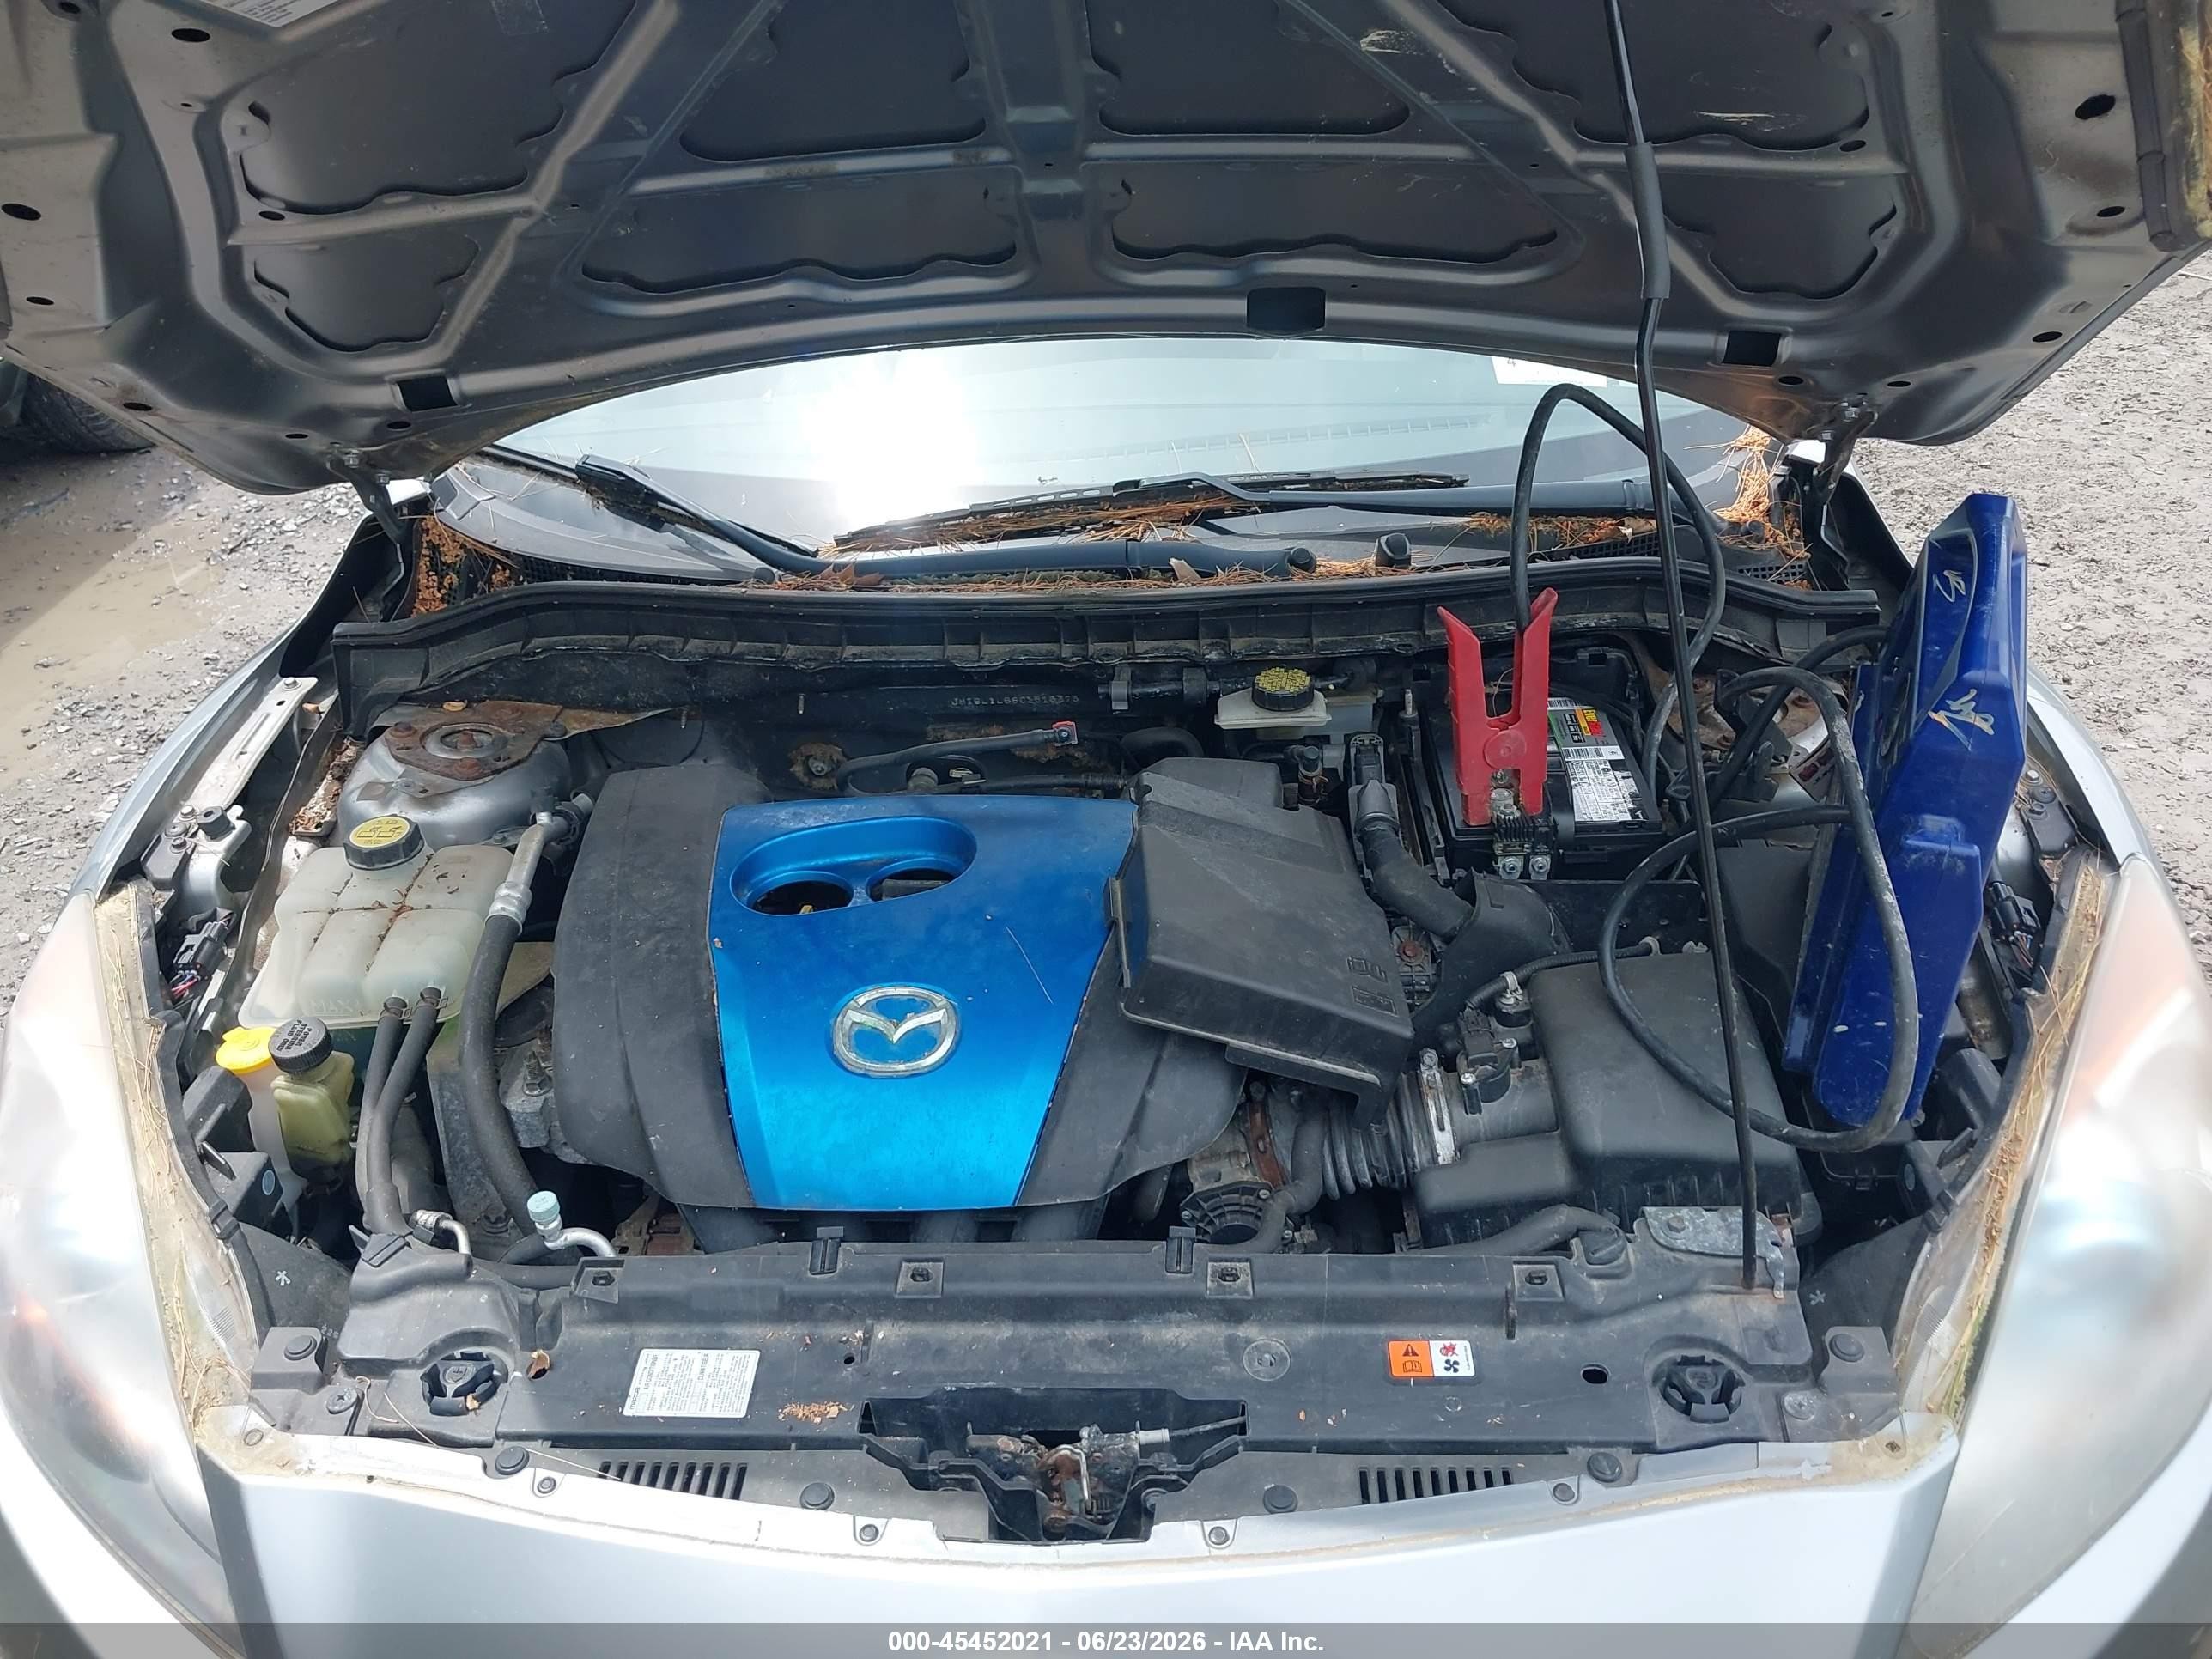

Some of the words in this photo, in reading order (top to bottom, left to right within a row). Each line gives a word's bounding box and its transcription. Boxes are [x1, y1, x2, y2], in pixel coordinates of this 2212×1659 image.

[285, 1023, 307, 1049] STEERING
[288, 1019, 302, 1036] FLUID
[295, 1027, 313, 1046] POWER
[629, 1387, 641, 1409] mazda
